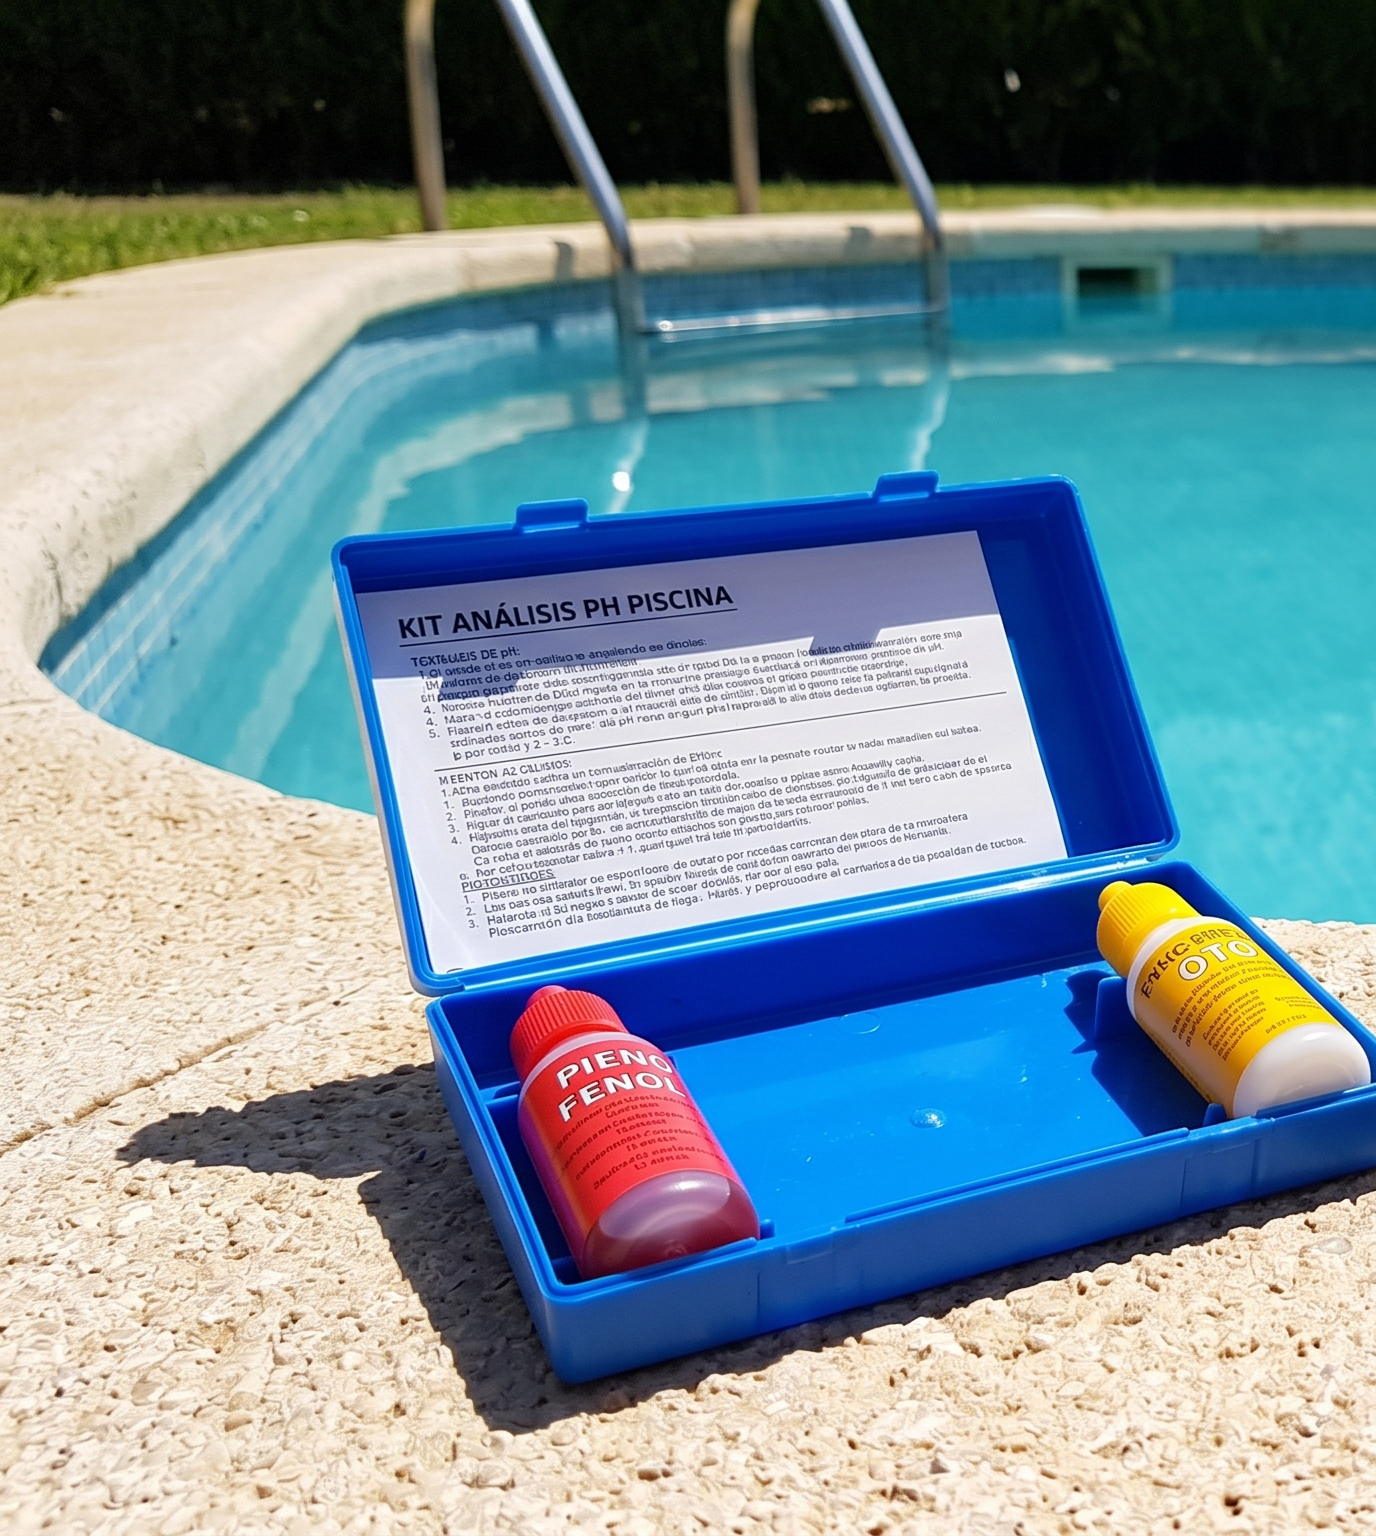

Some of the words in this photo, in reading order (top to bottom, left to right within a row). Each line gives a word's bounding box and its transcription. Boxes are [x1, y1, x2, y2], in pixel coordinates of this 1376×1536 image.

[397, 614, 443, 639] KIT
[452, 600, 577, 634] ANÁLISIS
[582, 596, 621, 619] PH
[626, 585, 734, 615] PISCINA
[479, 648, 499, 660] DE
[499, 646, 521, 660] pH:
[423, 705, 436, 715] 4.
[620, 682, 636, 691] en
[428, 728, 441, 739] 5.
[531, 716, 549, 726] de
[618, 715, 635, 728] pH
[571, 770, 587, 780] un
[672, 754, 688, 765] de
[445, 811, 457, 822] 2.
[642, 783, 657, 793] de
[450, 836, 463, 845] 4.
[550, 818, 569, 830] del
[768, 786, 783, 797] de
[897, 767, 911, 776] de
[710, 807, 725, 817] de
[866, 783, 880, 792] de
[959, 768, 973, 778] de
[447, 823, 460, 834] 3.
[473, 856, 490, 867] Ca
[717, 817, 737, 828] son
[725, 851, 745, 863] por
[887, 823, 902, 834] de
[719, 864, 734, 874] de
[889, 834, 903, 844] de
[654, 899, 670, 910] de
[897, 856, 911, 866] de
[974, 842, 989, 852] de
[467, 919, 480, 929] 3.
[651, 887, 666, 898] de
[1178, 939, 1259, 981] OTO
[556, 1071, 687, 1124] FENOL
